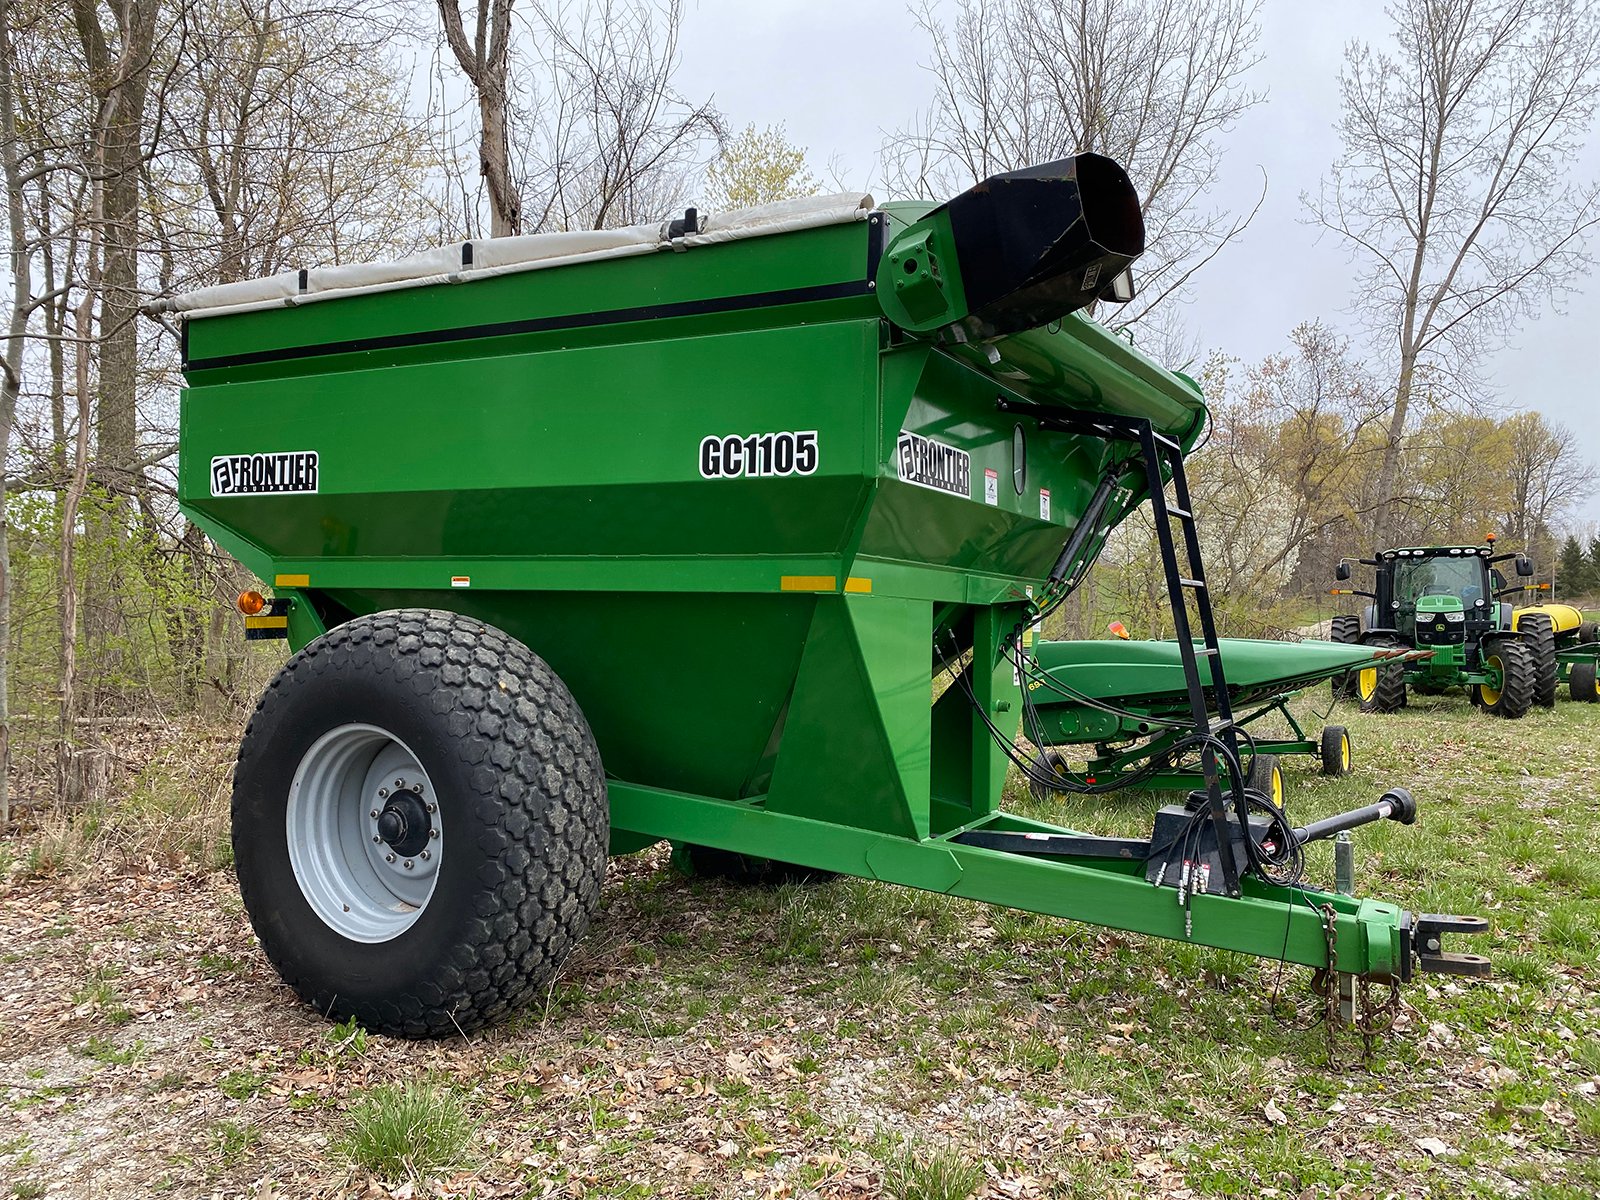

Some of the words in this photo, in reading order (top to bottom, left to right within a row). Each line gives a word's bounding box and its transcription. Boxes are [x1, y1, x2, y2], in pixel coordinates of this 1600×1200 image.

[229, 453, 317, 487] FRONTIER
[700, 432, 817, 477] GC1105
[914, 436, 970, 488] FRONTIER
[234, 484, 313, 493] EQUIPMENT
